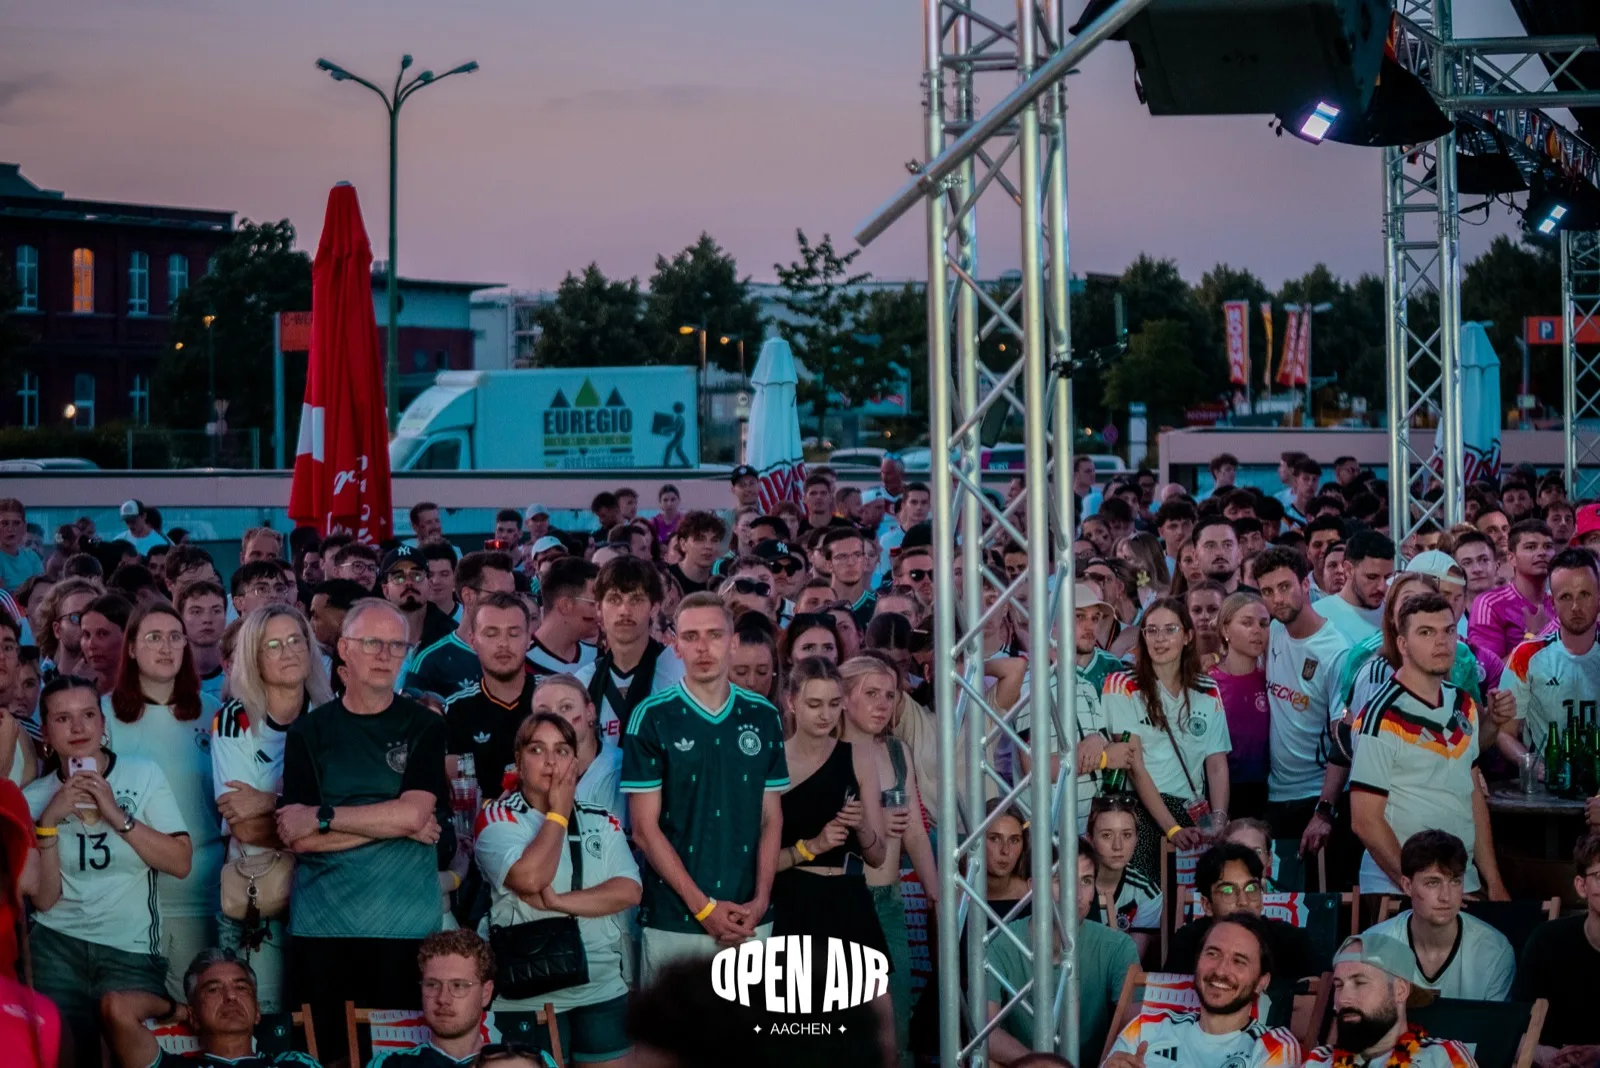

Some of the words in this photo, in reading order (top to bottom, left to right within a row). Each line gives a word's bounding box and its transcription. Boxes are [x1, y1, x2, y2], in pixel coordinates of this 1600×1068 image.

[1541, 322, 1552, 340] P
[543, 408, 633, 435] EUREGIO
[76, 831, 111, 871] 13
